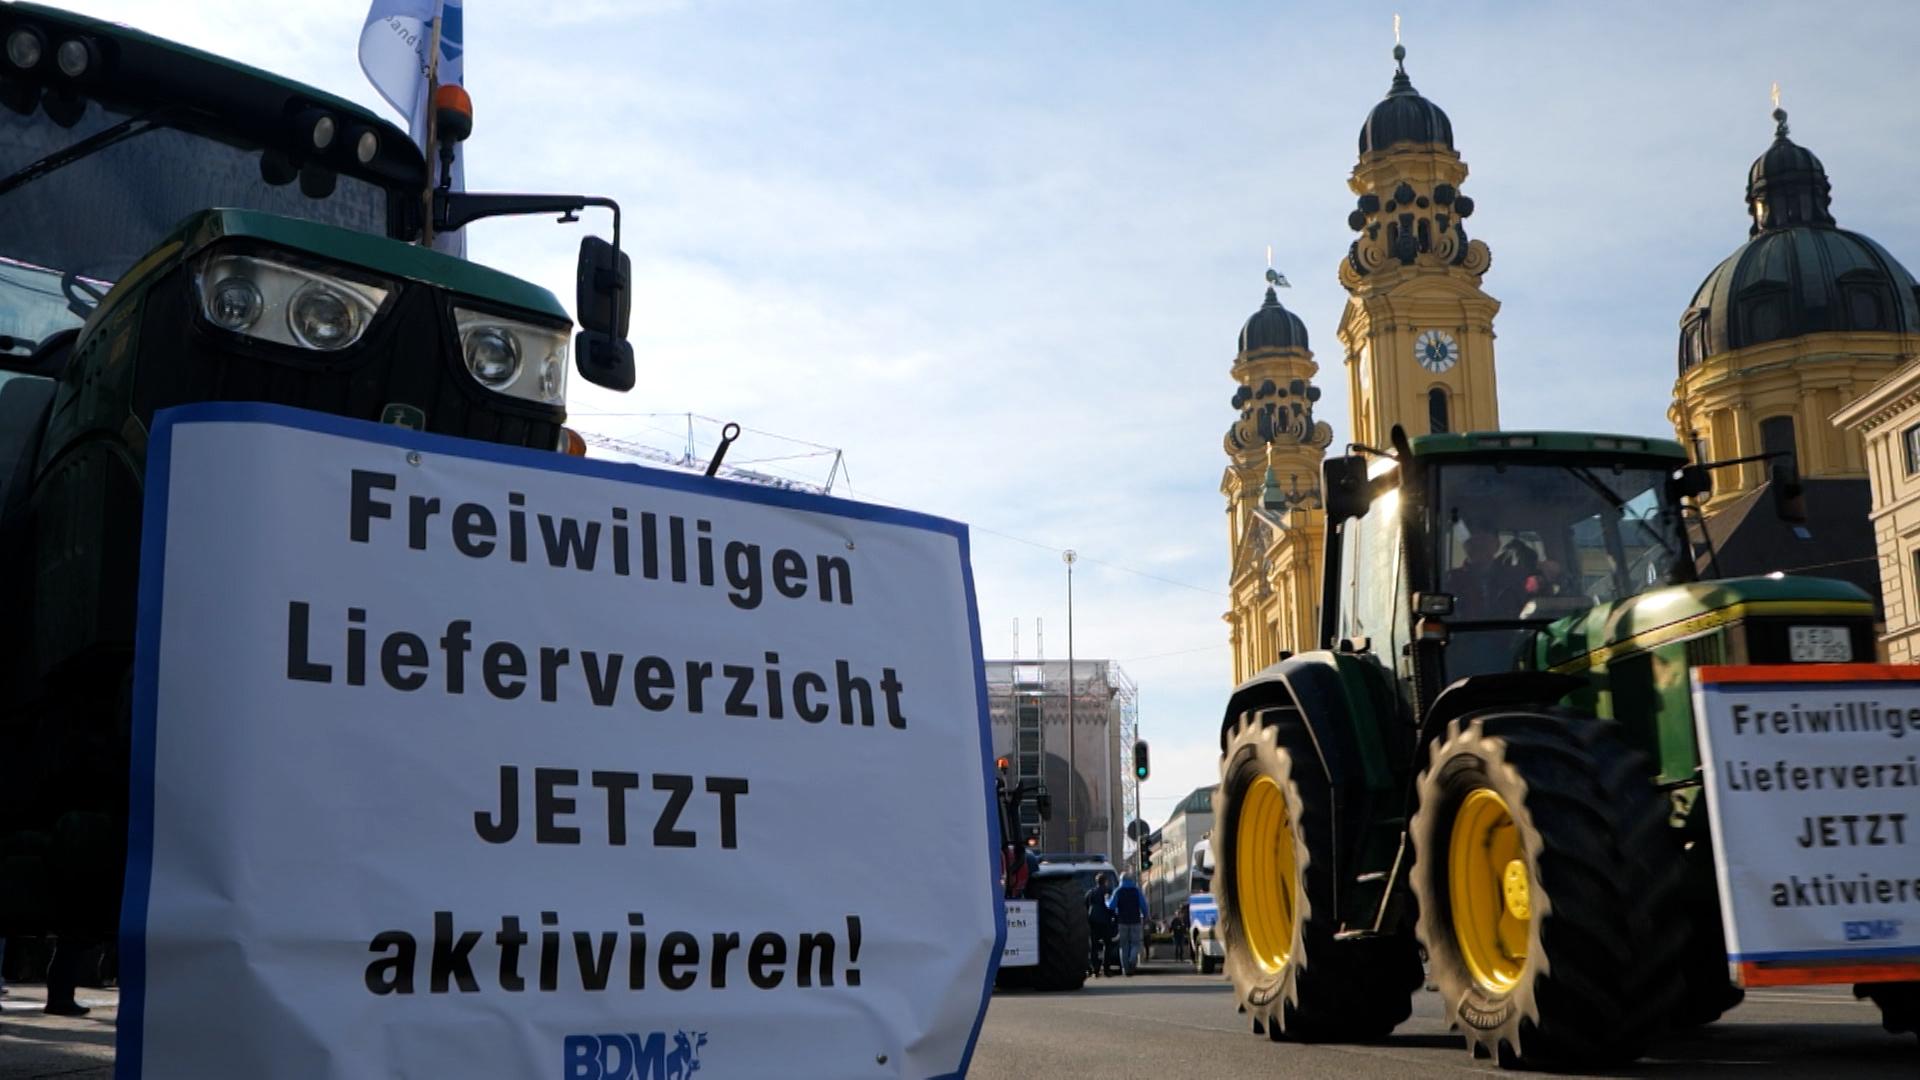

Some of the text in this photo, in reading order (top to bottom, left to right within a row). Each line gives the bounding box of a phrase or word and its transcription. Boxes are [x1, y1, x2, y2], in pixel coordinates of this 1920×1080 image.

[349, 468, 855, 611] Freiwilligen
[286, 600, 907, 730] Lieferverzicht
[473, 765, 750, 850] JETZT
[1726, 755, 1919, 792] Lieferverzi
[1797, 813, 1908, 849] JETZT
[364, 911, 863, 996] aktivieren!
[563, 1031, 666, 1080] BDM
